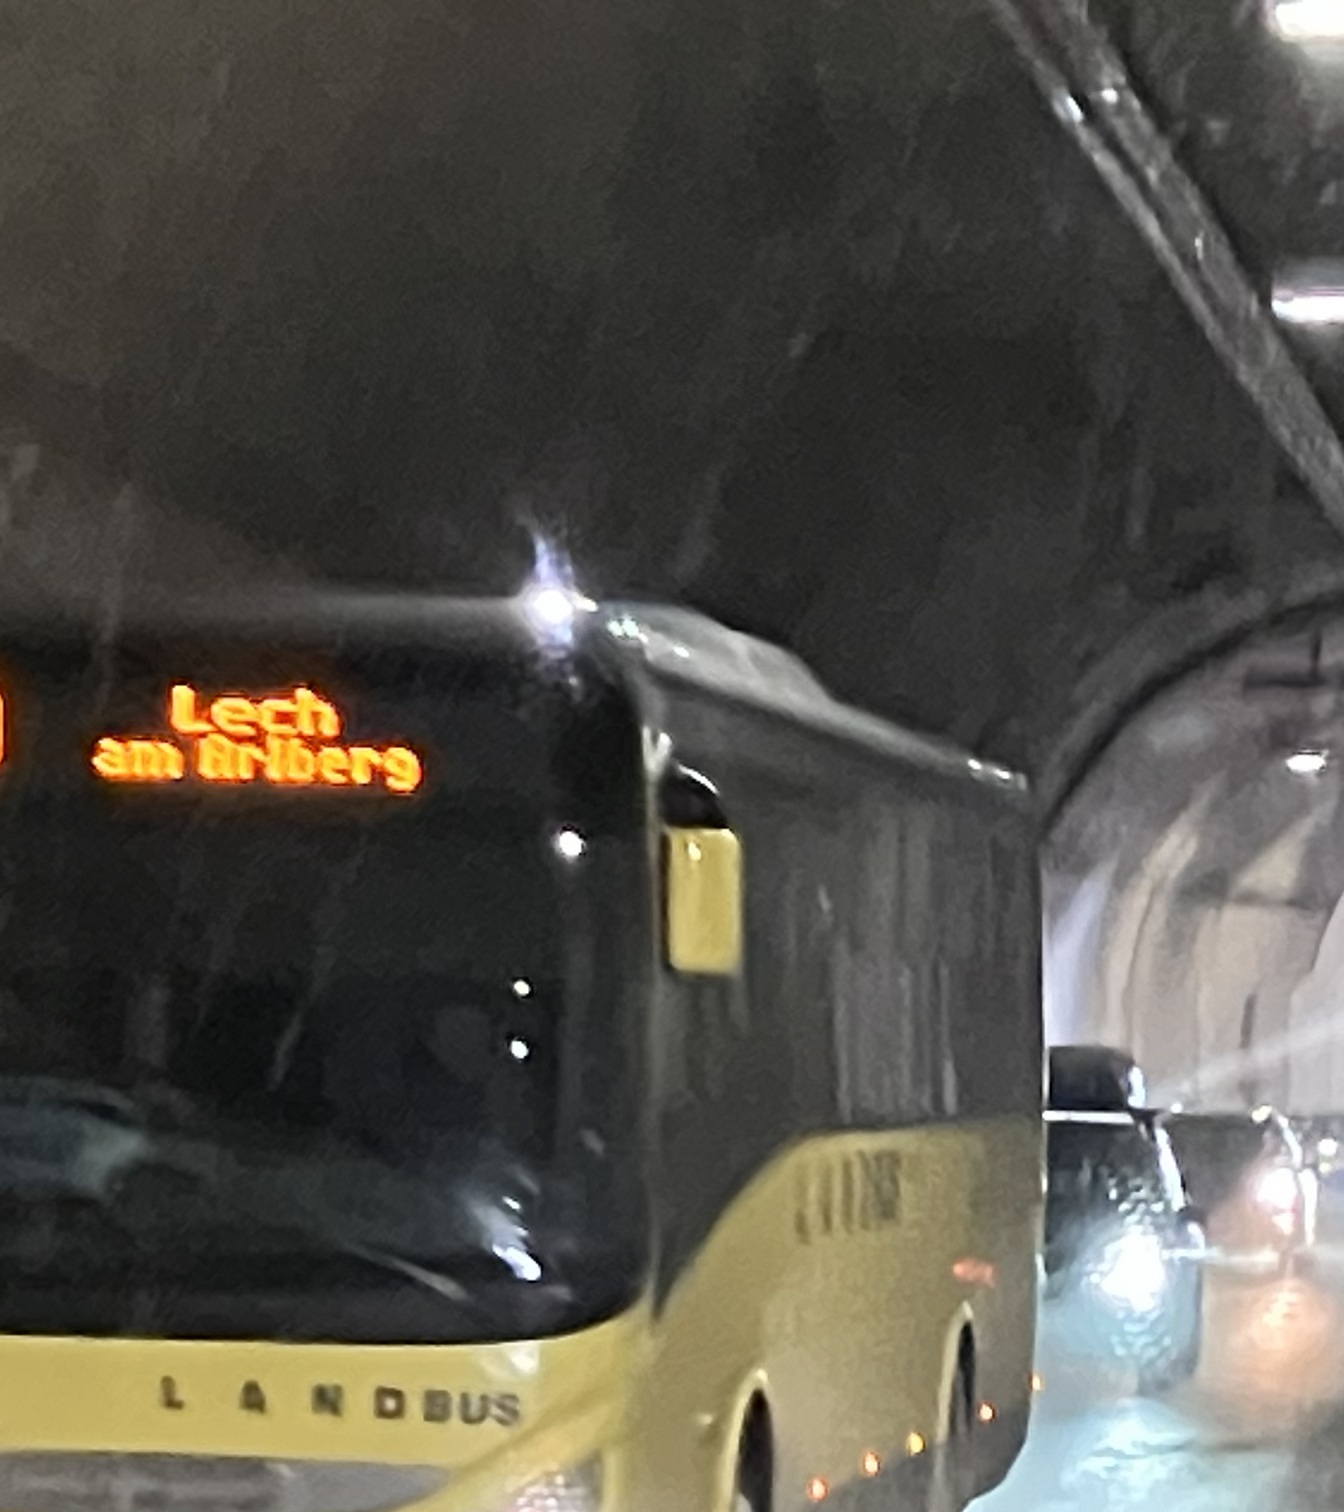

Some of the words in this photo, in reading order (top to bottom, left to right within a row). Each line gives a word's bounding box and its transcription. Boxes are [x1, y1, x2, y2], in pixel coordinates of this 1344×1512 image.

[172, 684, 340, 737] Lech
[93, 736, 183, 779] am
[198, 733, 422, 793] Arlberg
[161, 1375, 521, 1426] LANDBUS
